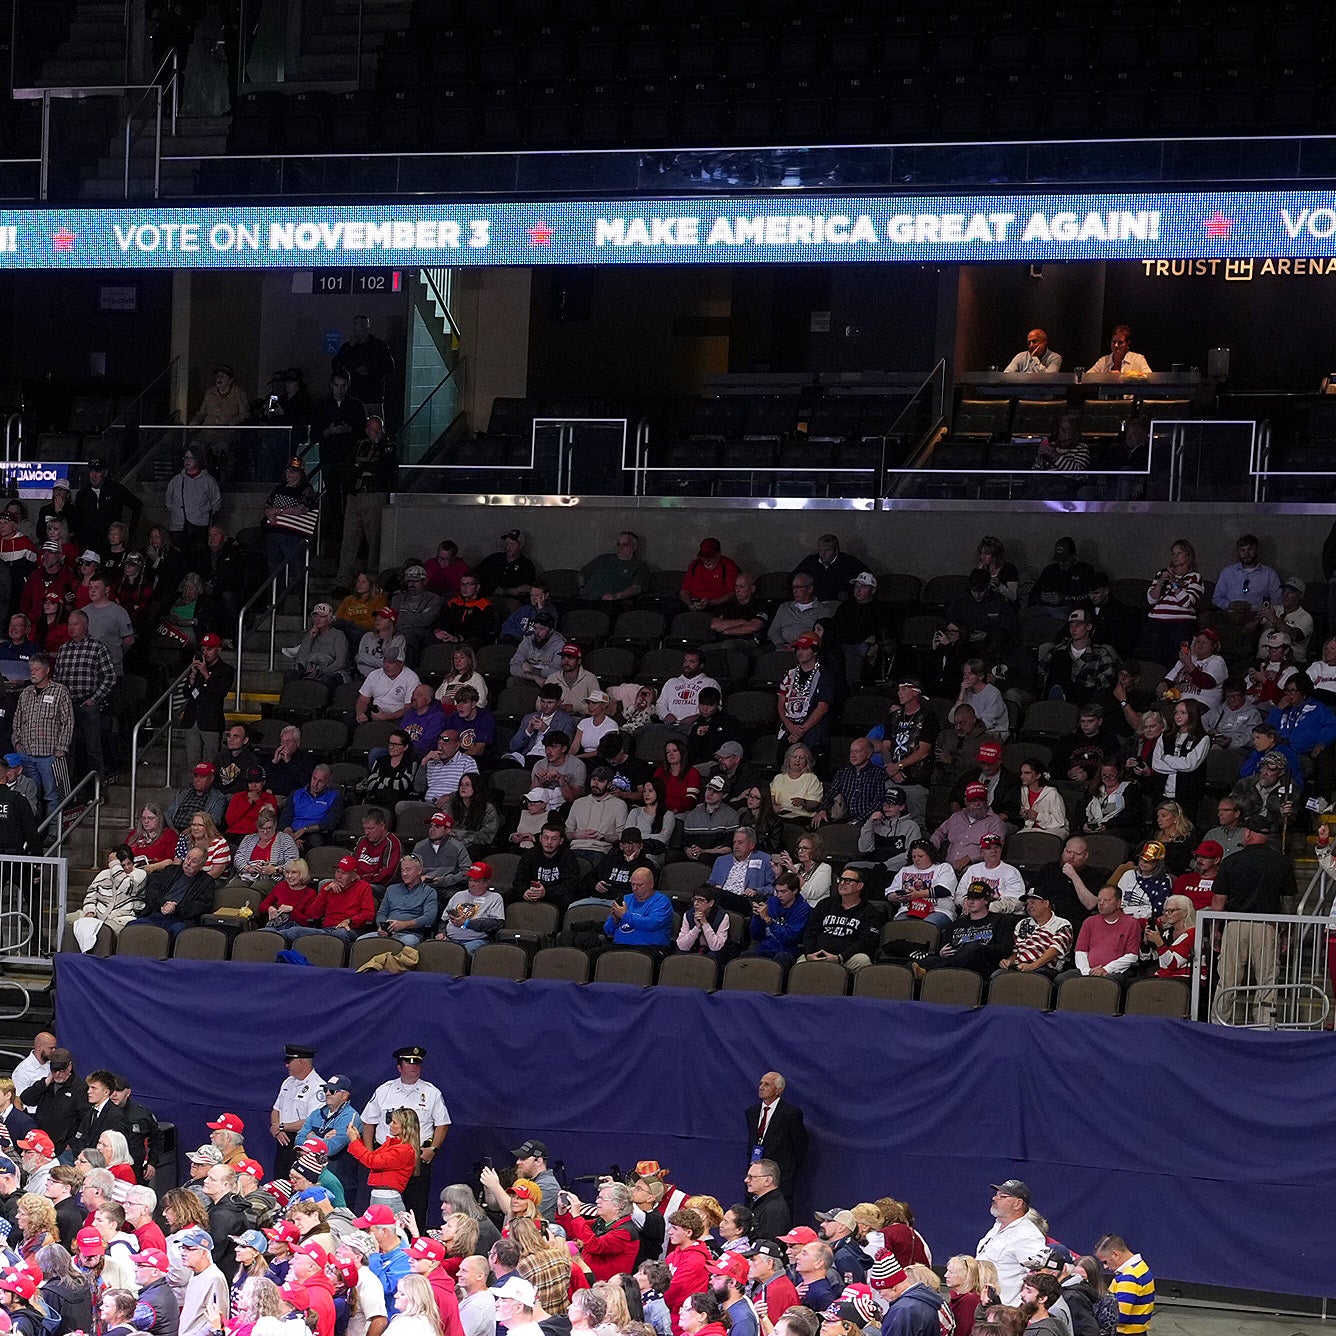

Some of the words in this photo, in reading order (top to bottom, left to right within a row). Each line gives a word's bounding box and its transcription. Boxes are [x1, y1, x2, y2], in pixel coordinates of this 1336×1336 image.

[114, 224, 201, 251] VOTE
[209, 224, 260, 251] ON
[269, 220, 462, 251] NOVEMBER
[468, 219, 489, 248] 3
[596, 217, 699, 247] MAKE
[707, 215, 878, 245] AMERICA
[887, 213, 1016, 243] GREAT
[1023, 211, 1160, 240] AGAIN!
[1142, 259, 1221, 276] TRUIST
[1260, 258, 1336, 275] ARENA
[320, 277, 343, 290] 101
[360, 277, 385, 290] 102
[157, 624, 168, 636] NO
[822, 915, 861, 930] WRIGLEY
